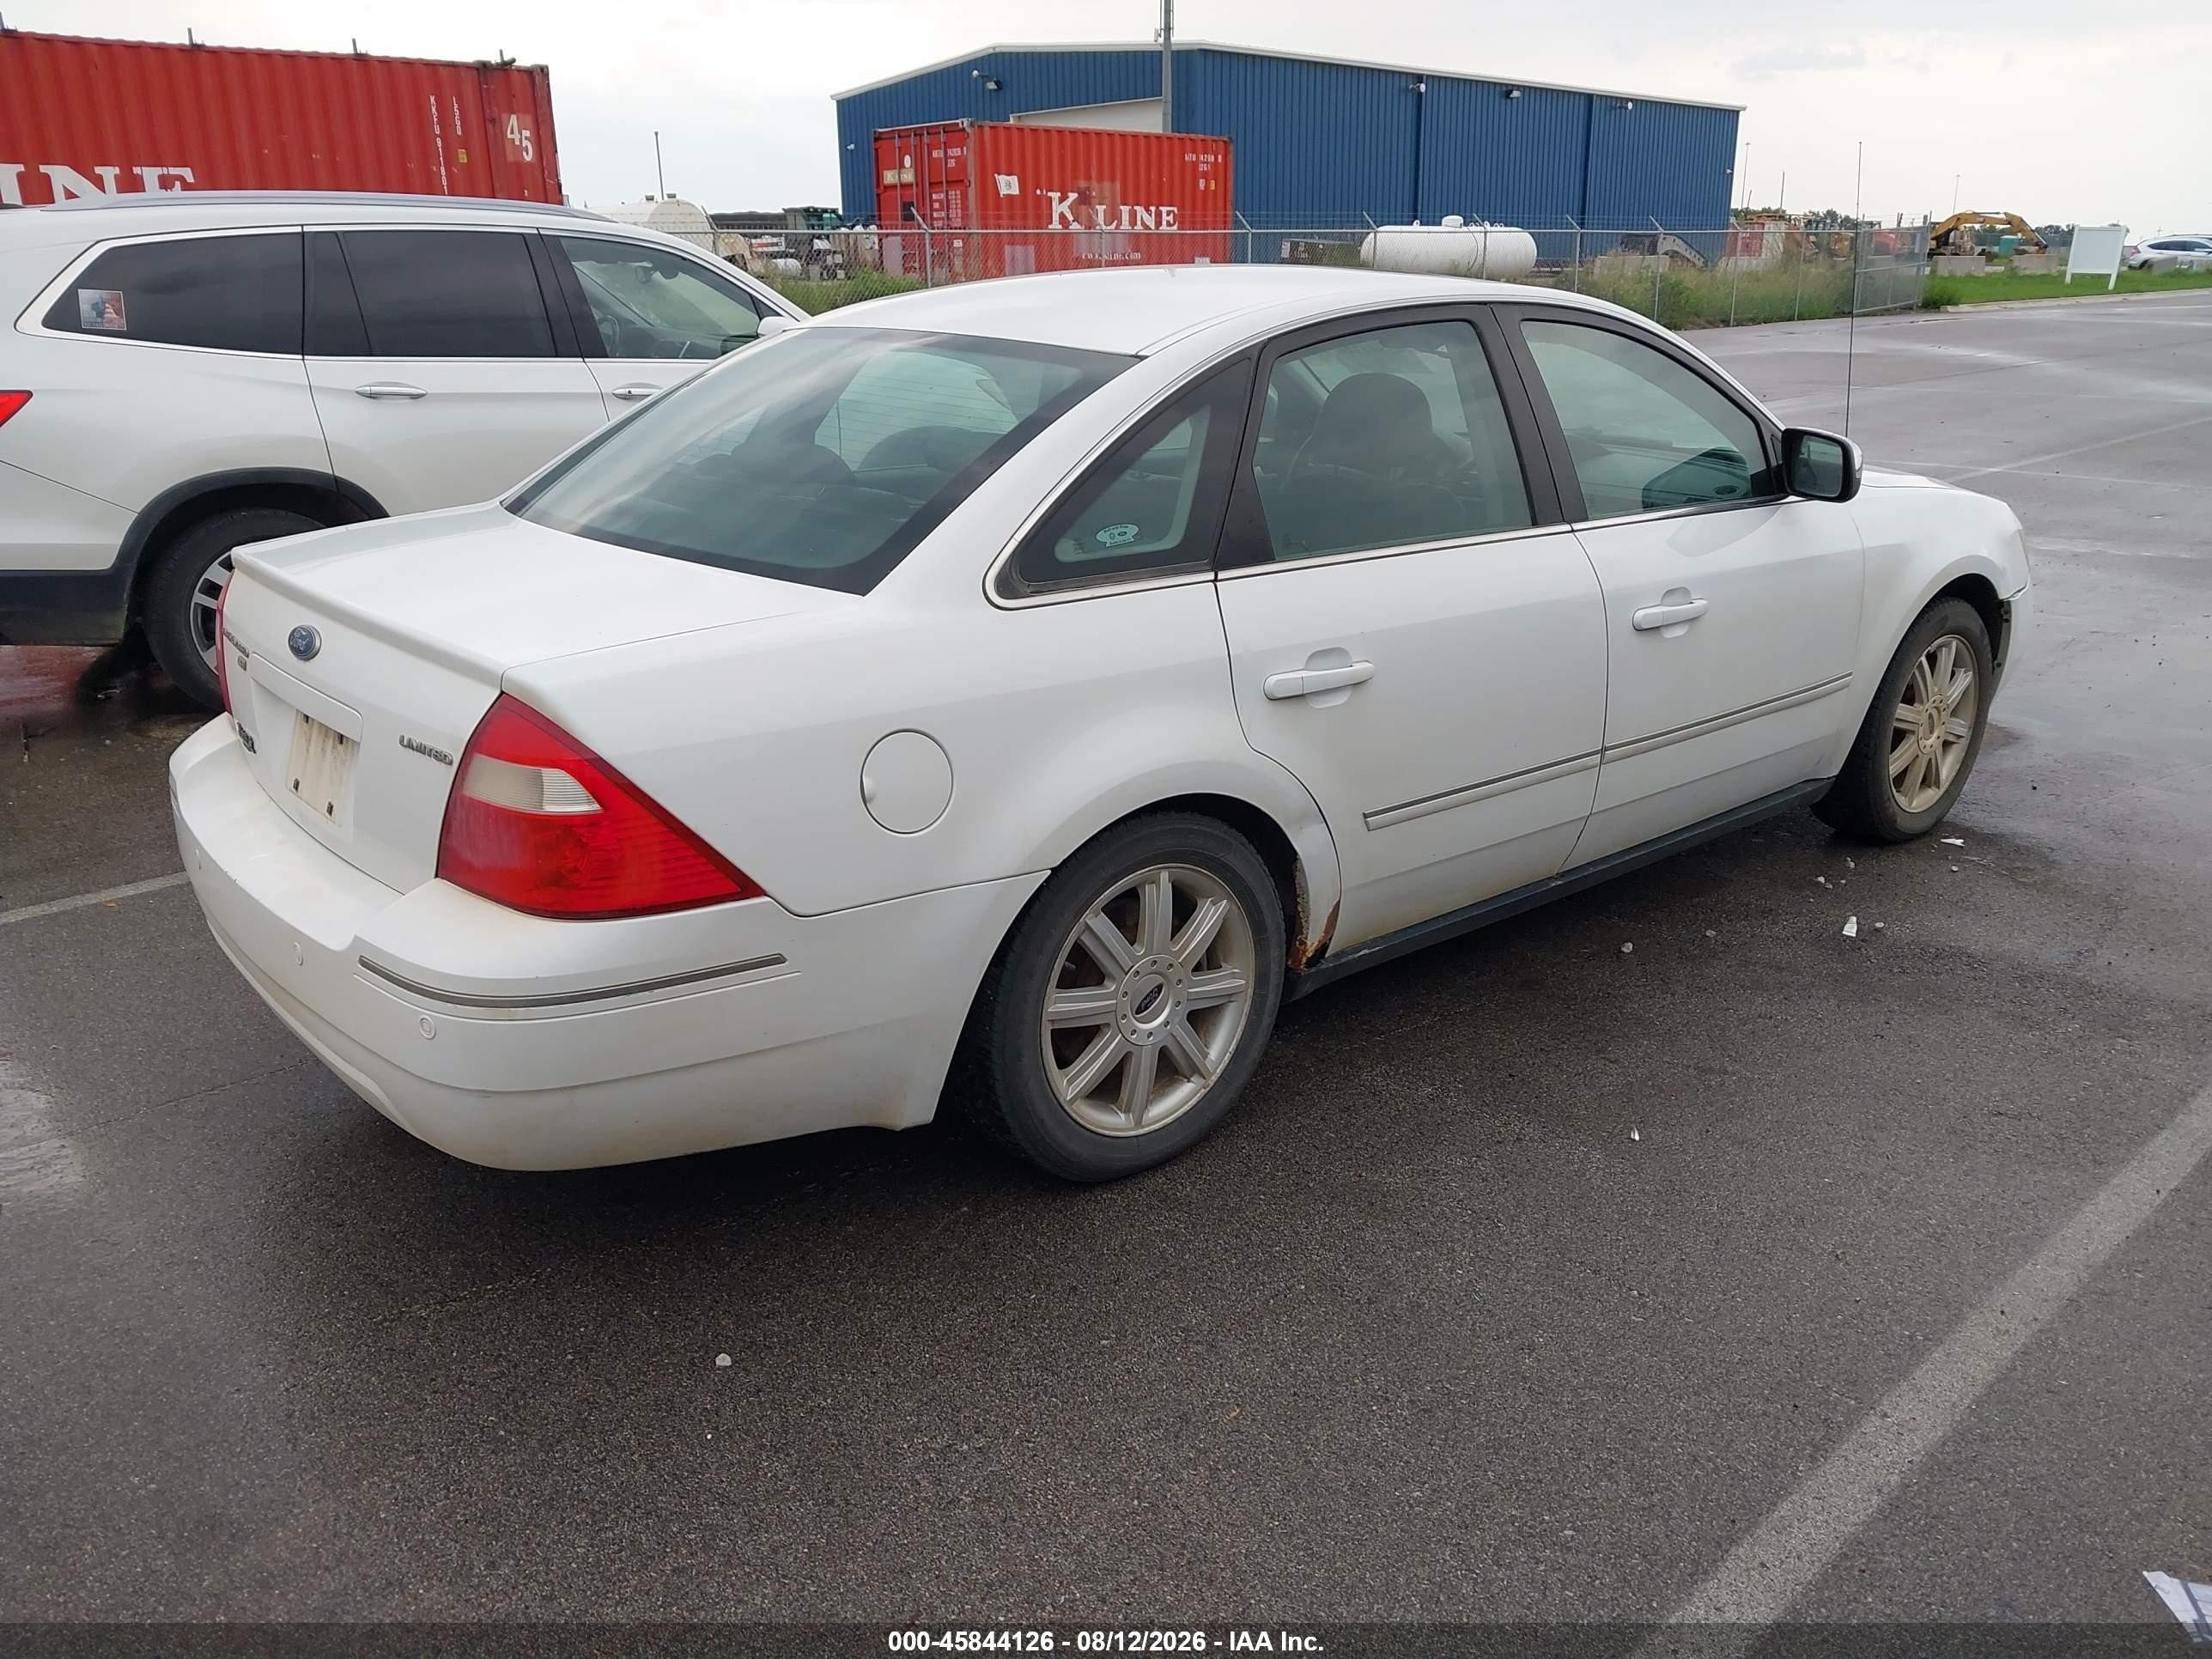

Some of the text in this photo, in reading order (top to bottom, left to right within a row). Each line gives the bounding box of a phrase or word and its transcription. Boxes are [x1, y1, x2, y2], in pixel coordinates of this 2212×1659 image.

[429, 94, 441, 135] KKFU
[507, 113, 533, 161] 45
[1096, 204, 1178, 230] LINE
[398, 734, 453, 766] LIMITED
